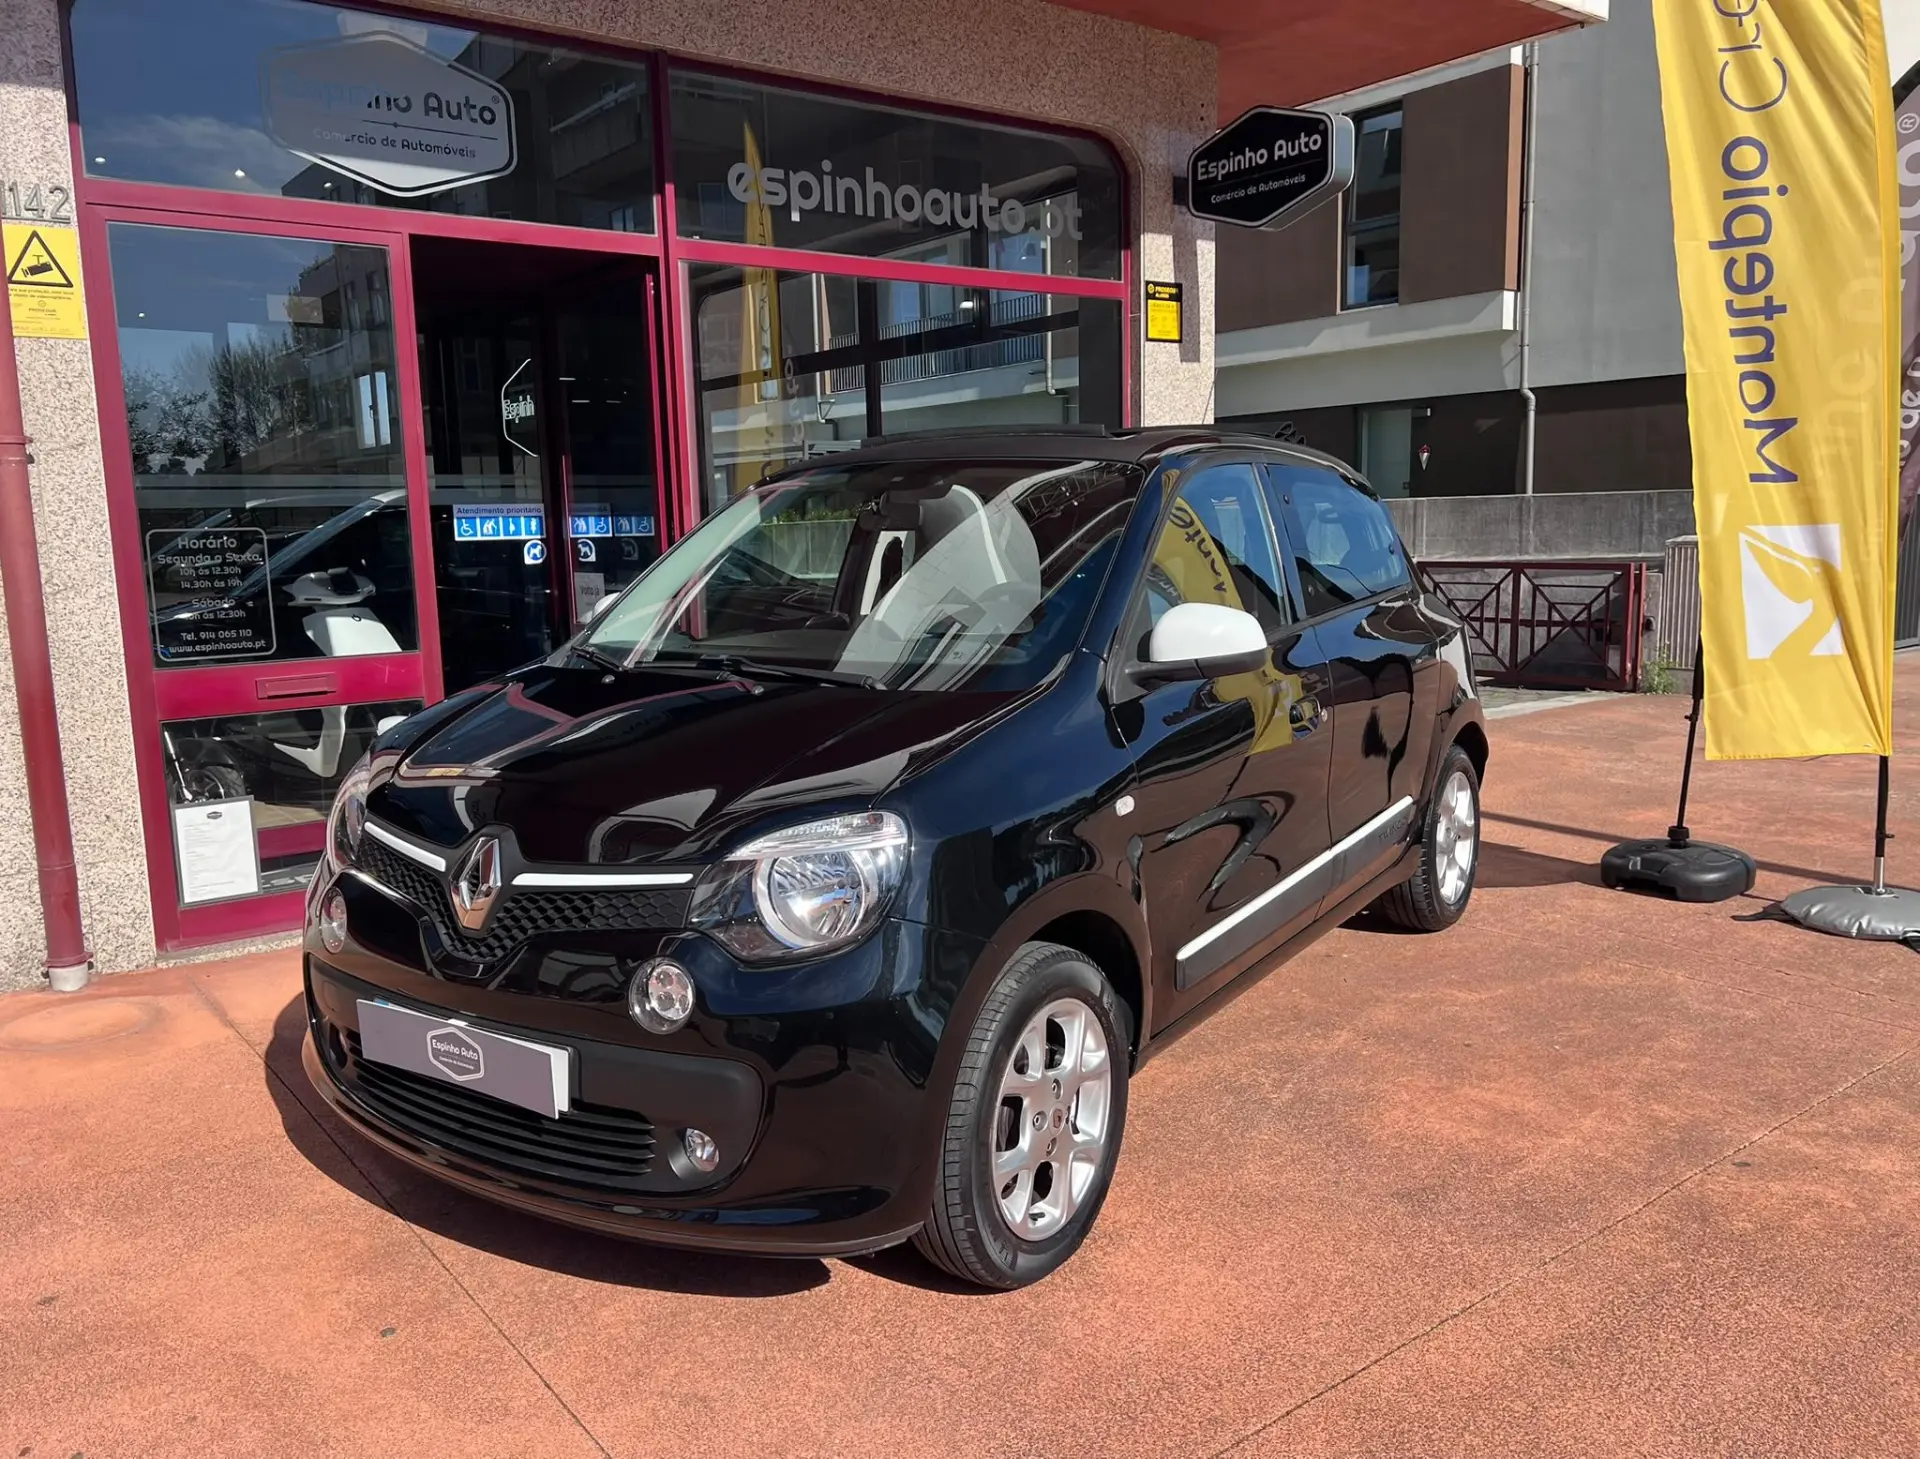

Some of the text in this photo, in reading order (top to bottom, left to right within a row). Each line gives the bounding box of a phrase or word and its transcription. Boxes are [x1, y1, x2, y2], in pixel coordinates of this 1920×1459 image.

[424, 92, 497, 125] Auto
[381, 136, 397, 148] de
[401, 138, 476, 158] Automóveis
[1197, 132, 1322, 181] Espinho Auto
[1247, 186, 1257, 195] de
[1259, 173, 1306, 191] Automóveis
[727, 159, 1083, 241] espinhoauto.pt
[456, 506, 505, 514] Atendimento
[178, 536, 237, 549] Horário
[157, 554, 211, 565] Segunda
[180, 580, 211, 589] 14.30h
[200, 630, 215, 640] 914
[217, 629, 237, 639] 065
[239, 628, 252, 638] 110
[168, 639, 267, 653] www.espinhoauto.pt
[431, 1038, 479, 1060] Espinho Auto
